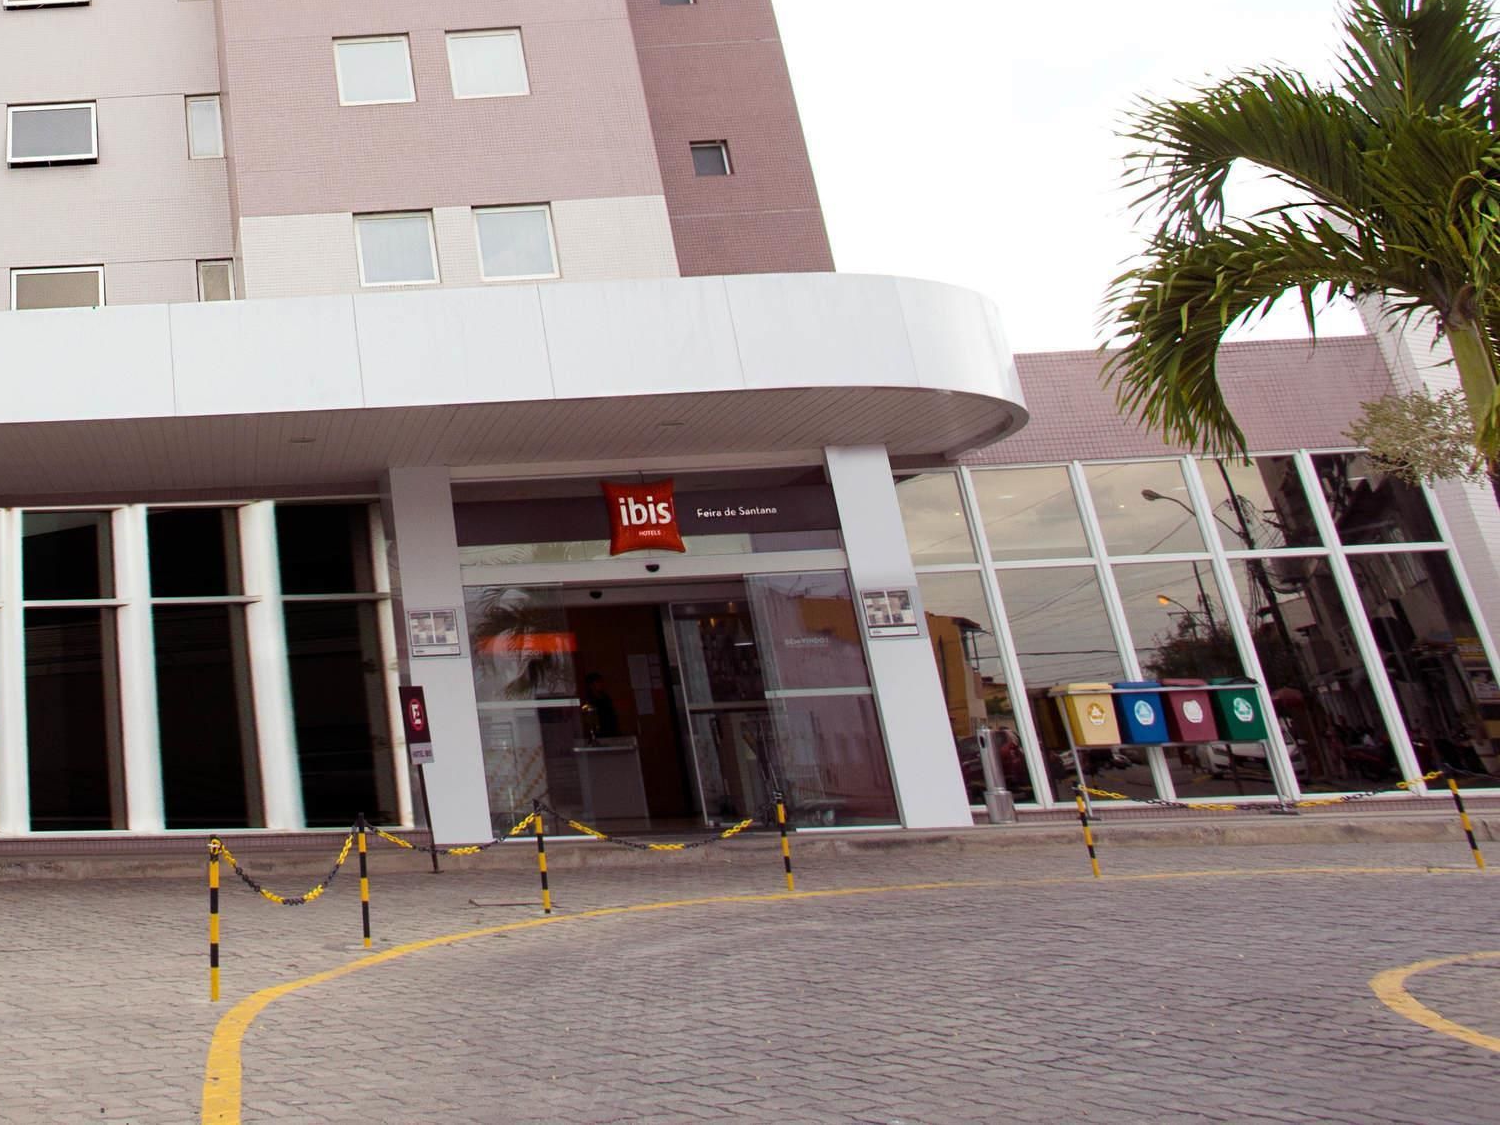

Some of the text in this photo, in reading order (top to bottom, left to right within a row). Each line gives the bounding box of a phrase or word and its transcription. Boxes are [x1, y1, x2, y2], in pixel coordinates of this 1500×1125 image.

[618, 495, 673, 527] ibis
[696, 505, 778, 518] Feira de Santana
[638, 529, 663, 537] HOTELS
